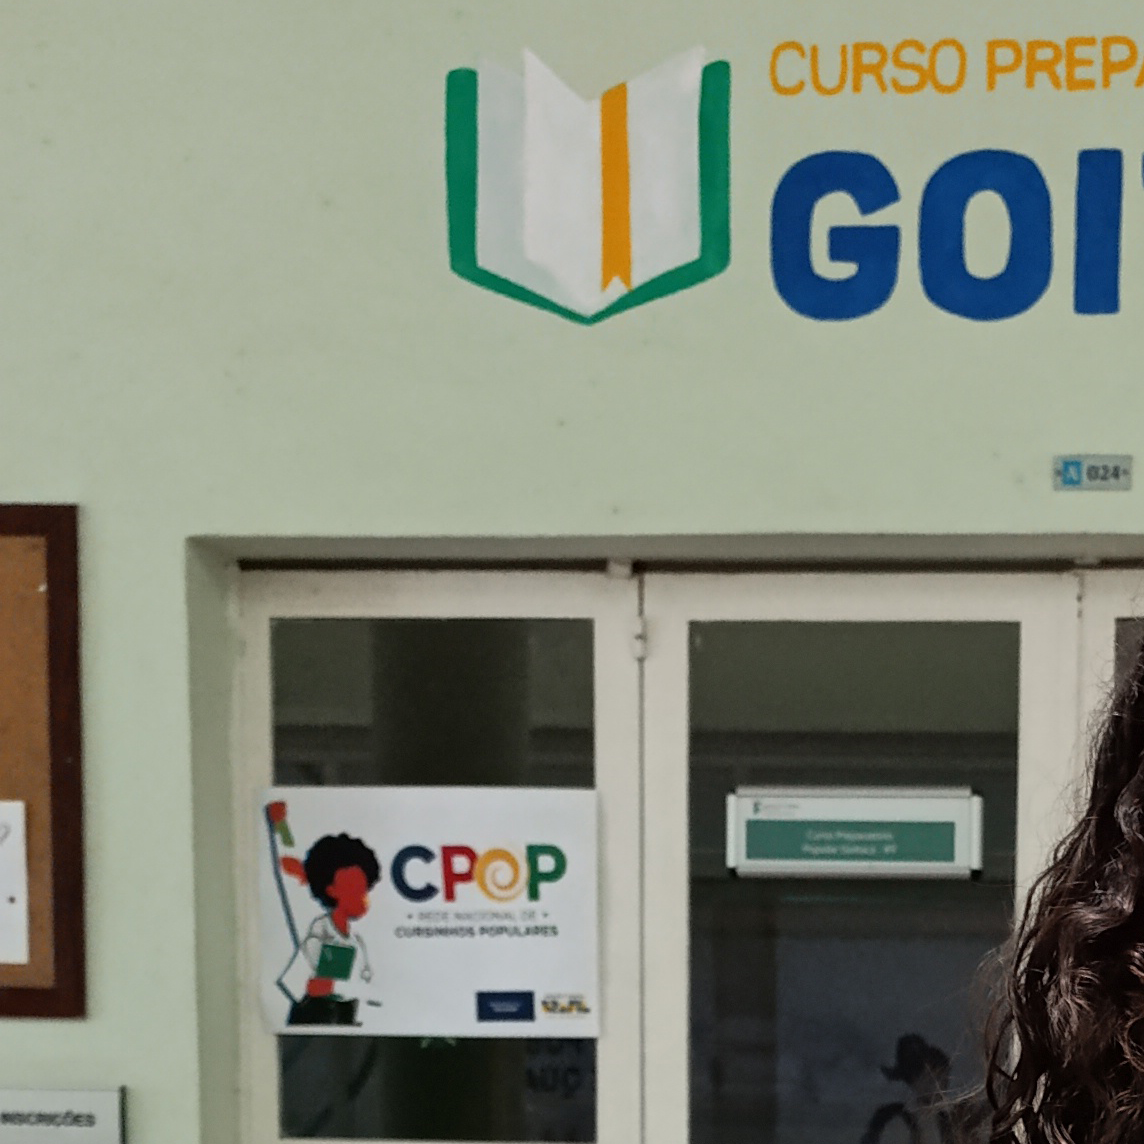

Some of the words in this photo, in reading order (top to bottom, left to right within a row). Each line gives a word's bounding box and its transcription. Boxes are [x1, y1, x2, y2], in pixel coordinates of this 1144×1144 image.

[769, 39, 966, 95] CURSO
[390, 843, 568, 903] CPOP
[394, 925, 476, 939] CURSINHOS
[478, 925, 559, 938] POPULARES
